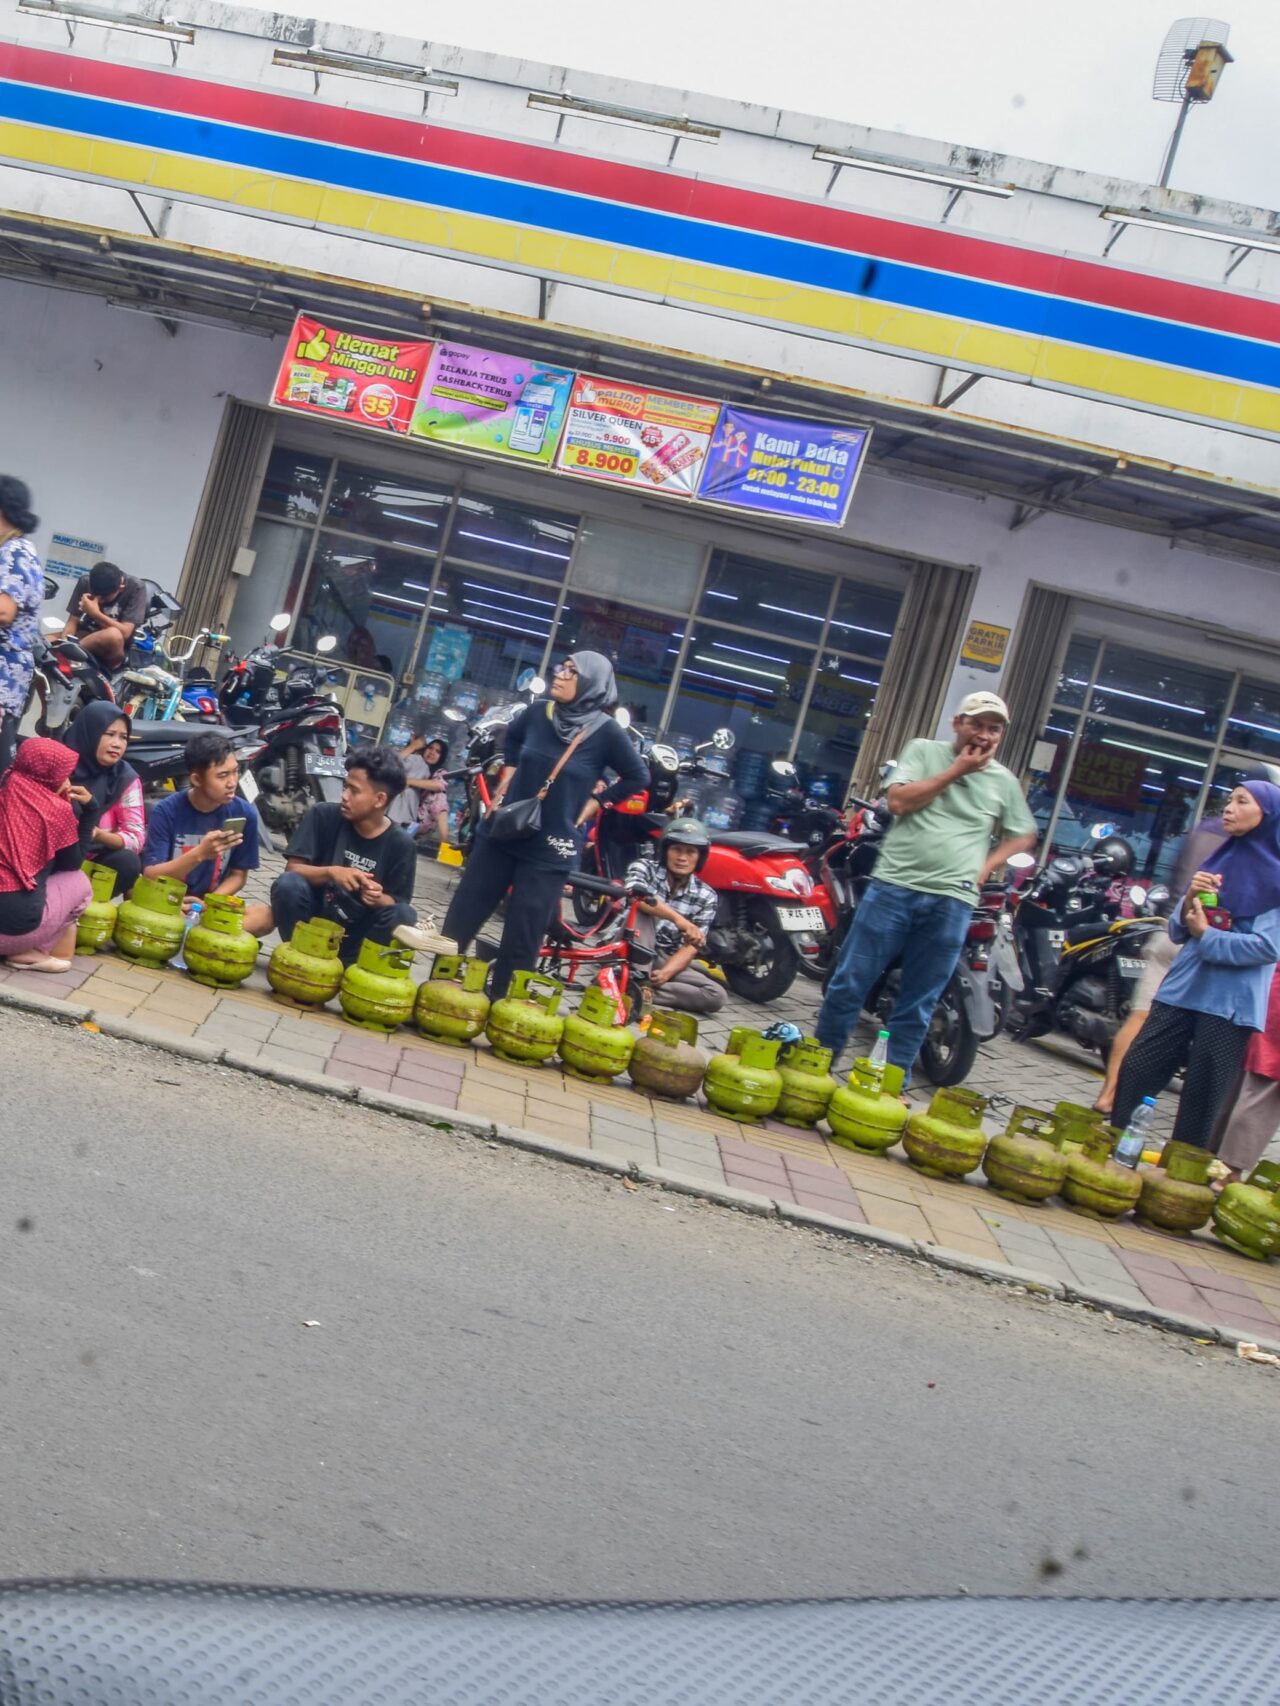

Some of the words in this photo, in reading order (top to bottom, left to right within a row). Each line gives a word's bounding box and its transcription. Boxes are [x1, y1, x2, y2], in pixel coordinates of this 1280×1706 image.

[334, 332, 400, 362] Hemat
[329, 351, 387, 377] Minggu
[439, 364, 478, 378] BELANJA
[480, 372, 508, 385] TERUS
[436, 374, 485, 391] CASHBACK
[484, 386, 513, 398] TERUS
[363, 395, 392, 416] 35
[572, 409, 607, 424] SILVER
[608, 416, 644, 431] QUEEN
[603, 433, 631, 446] 9.900
[754, 432, 801, 457] Kami
[805, 442, 849, 466] Buka
[576, 449, 634, 474] 8.900
[750, 449, 790, 468] Mulai
[790, 458, 831, 477] Pukul
[796, 476, 840, 499] 23:00
[967, 634, 1003, 649] PARKIR
[969, 627, 1006, 642] GRATIS
